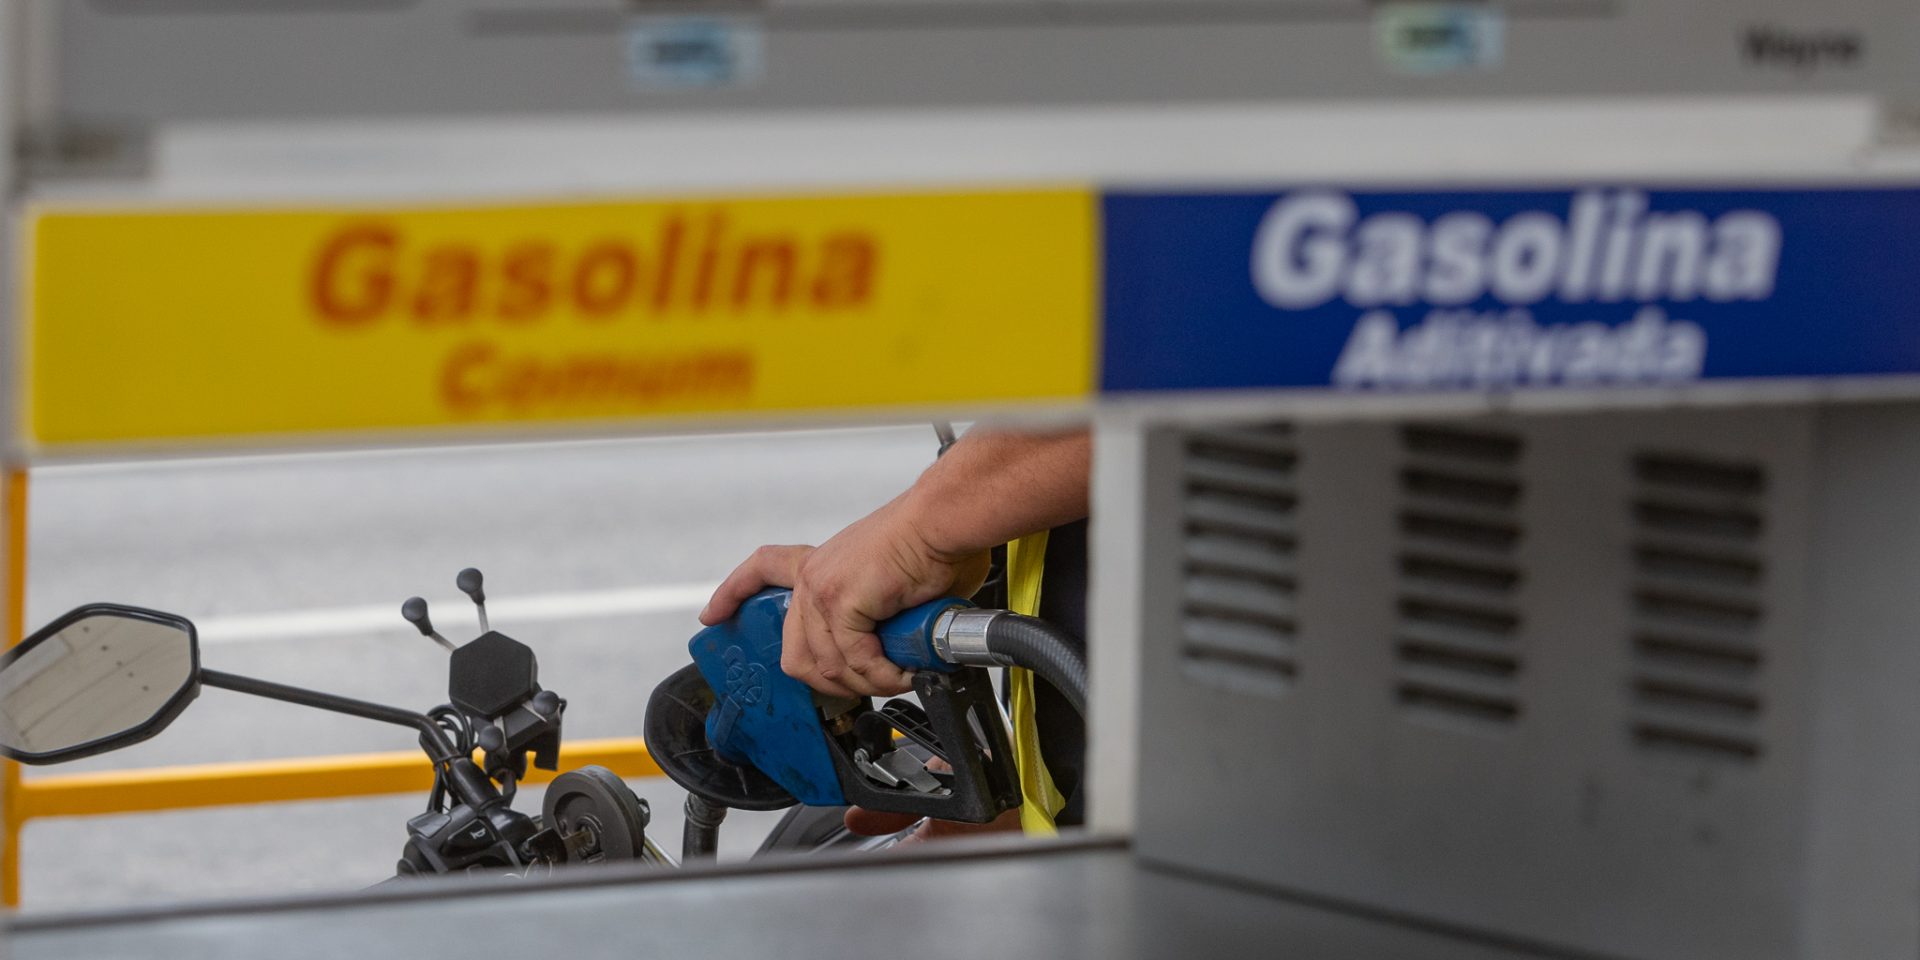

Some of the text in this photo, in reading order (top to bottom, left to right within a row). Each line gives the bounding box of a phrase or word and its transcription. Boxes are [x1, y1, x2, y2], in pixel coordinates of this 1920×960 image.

[307, 210, 880, 328] Gasolina
[1252, 188, 1783, 308] Gasolina
[440, 342, 756, 412] Comum
[1332, 308, 1707, 388] Aditivada
